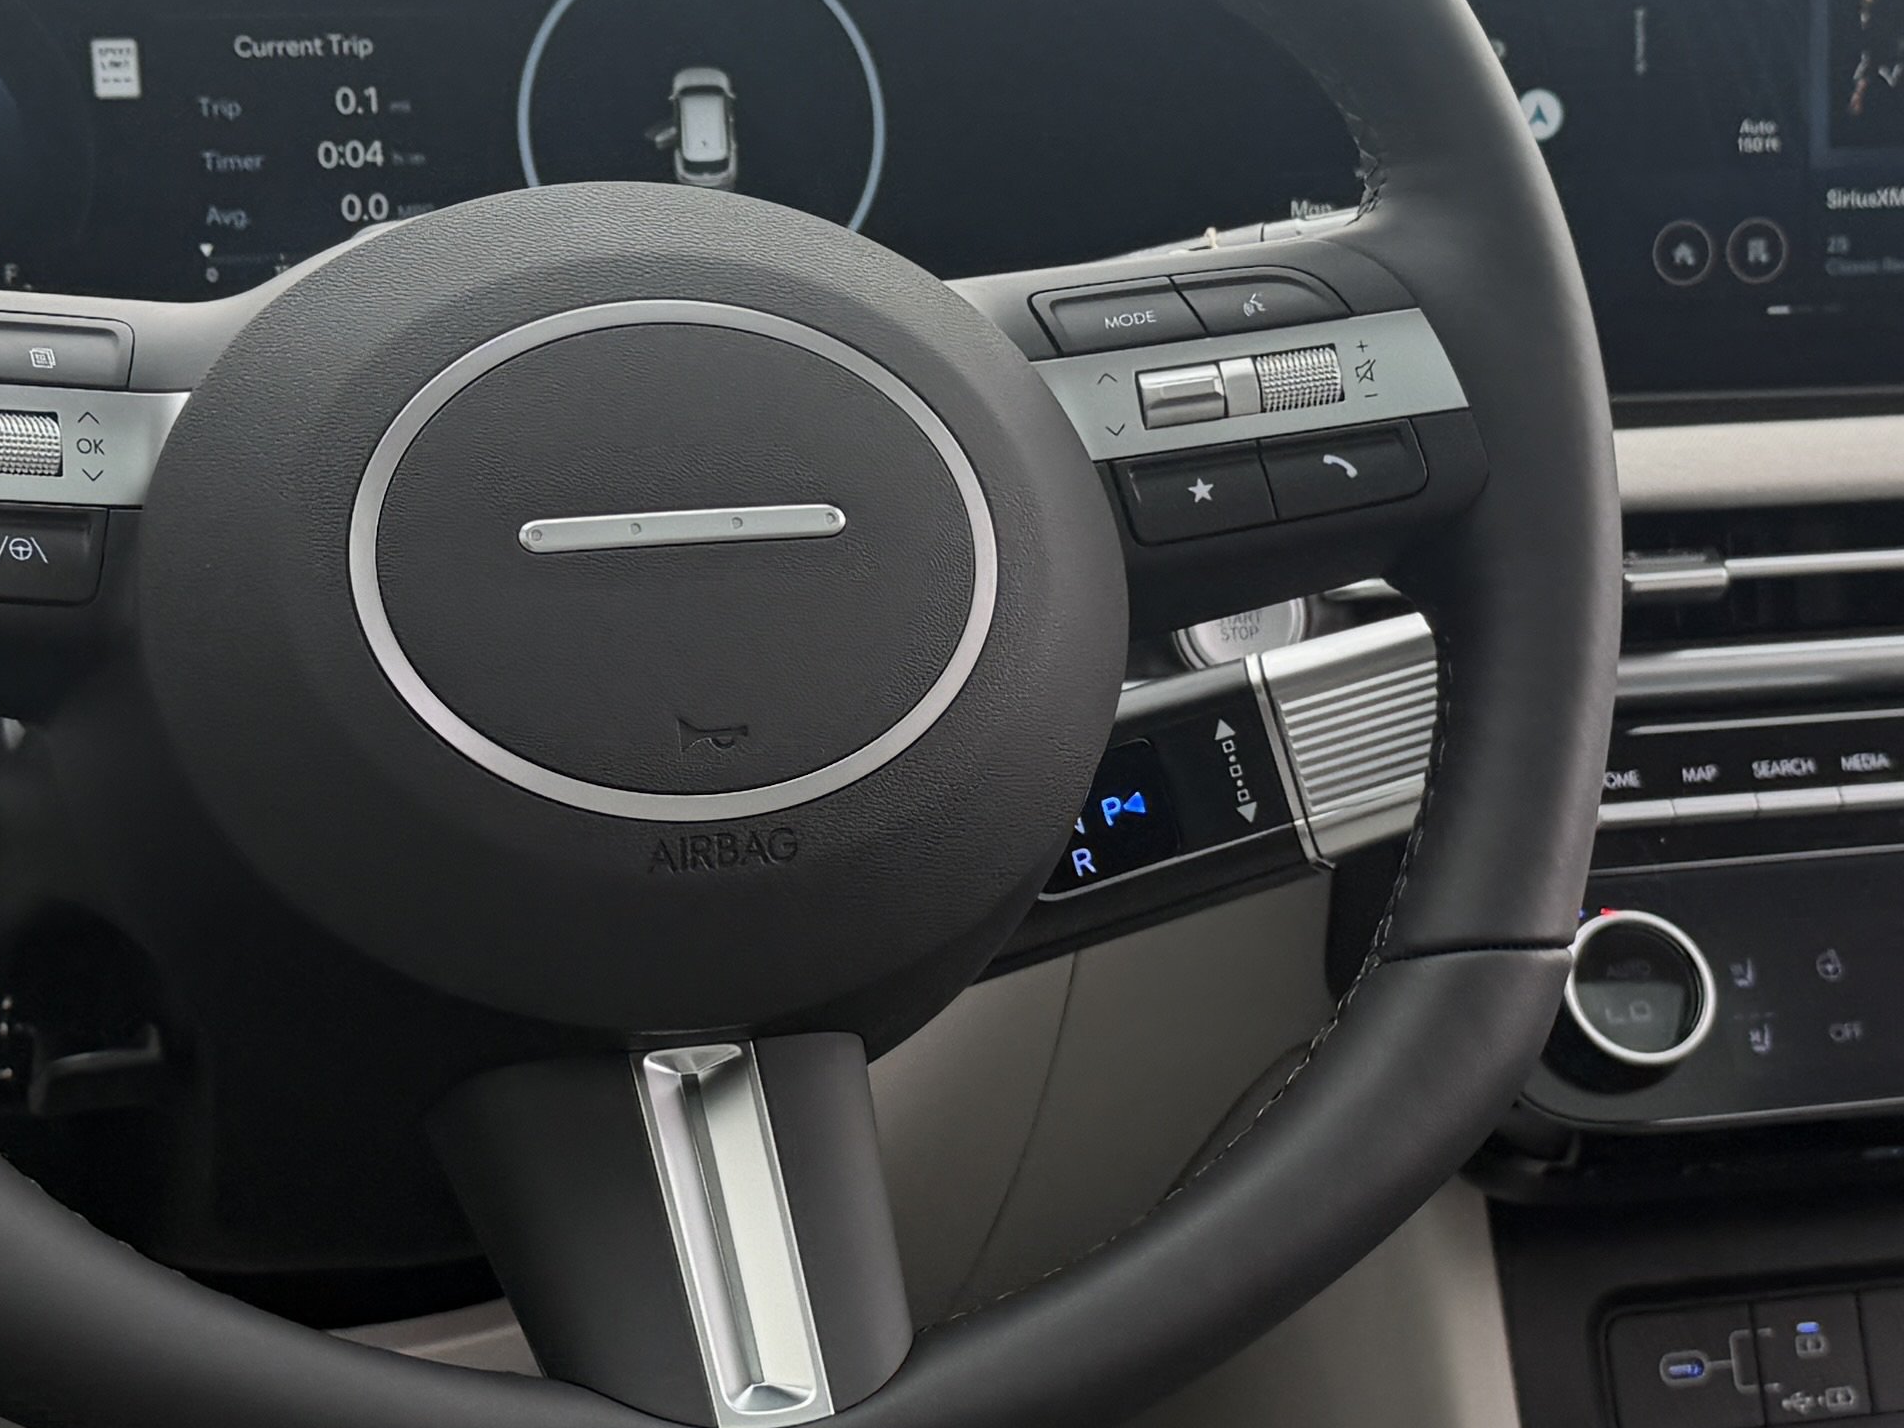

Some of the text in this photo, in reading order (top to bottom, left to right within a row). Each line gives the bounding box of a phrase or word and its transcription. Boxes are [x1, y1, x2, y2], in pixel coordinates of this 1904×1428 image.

[233, 33, 374, 59] Current Trip
[198, 96, 242, 120] Trip
[335, 86, 378, 115] 0.1
[1739, 118, 1777, 135] Auto
[202, 151, 264, 171] Timer
[317, 140, 384, 169] 0:04
[340, 193, 389, 222] 0.0
[1104, 310, 1157, 329] MODE
[76, 437, 105, 456] OK
[1220, 626, 1259, 642] STOP
[1752, 757, 1815, 780] SEARCH
[1841, 751, 1889, 772] MEDIA
[1603, 770, 1641, 789] OME
[1682, 764, 1717, 783] MAP
[1101, 797, 1121, 826] P
[648, 826, 798, 876] AIRBAG
[1073, 848, 1096, 877] R
[1829, 1021, 1863, 1043] OFF
